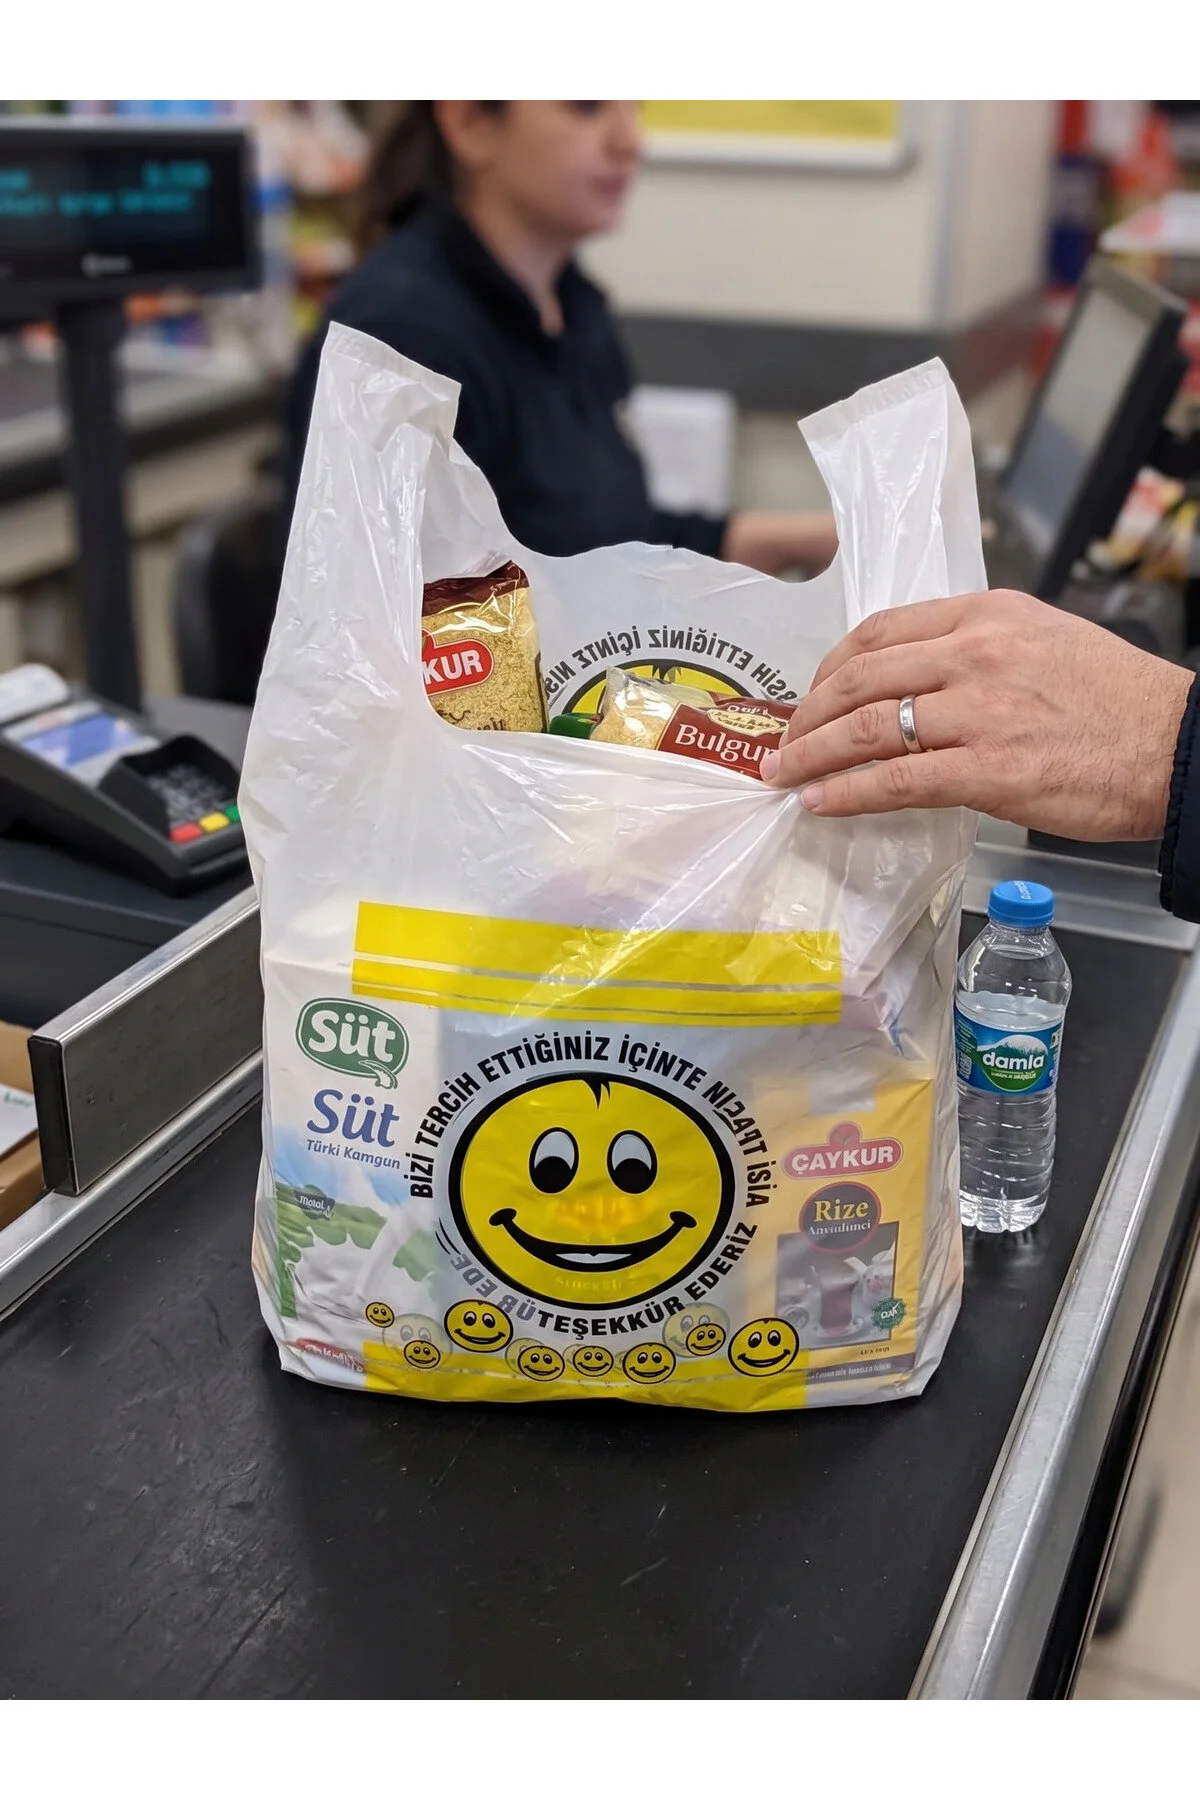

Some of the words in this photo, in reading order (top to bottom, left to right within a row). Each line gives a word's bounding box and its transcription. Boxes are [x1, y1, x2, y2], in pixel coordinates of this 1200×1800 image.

[308, 1009, 396, 1063] Süt
[476, 1030, 611, 1083] ETTİĞİNİZ
[982, 1051, 1045, 1071] damla
[618, 1034, 708, 1091] İÇİNTE
[306, 1088, 400, 1148] Süt
[414, 1072, 482, 1148] TERCİH
[306, 1138, 341, 1157] Türki
[343, 1146, 401, 1169] Kamgun
[403, 1152, 435, 1199] BİZİ
[791, 1145, 894, 1175] ÇAYKUR
[814, 1198, 870, 1222] Rize
[684, 1222, 758, 1301] EDERİZ
[536, 1295, 686, 1340] TEŞEKKÜR
